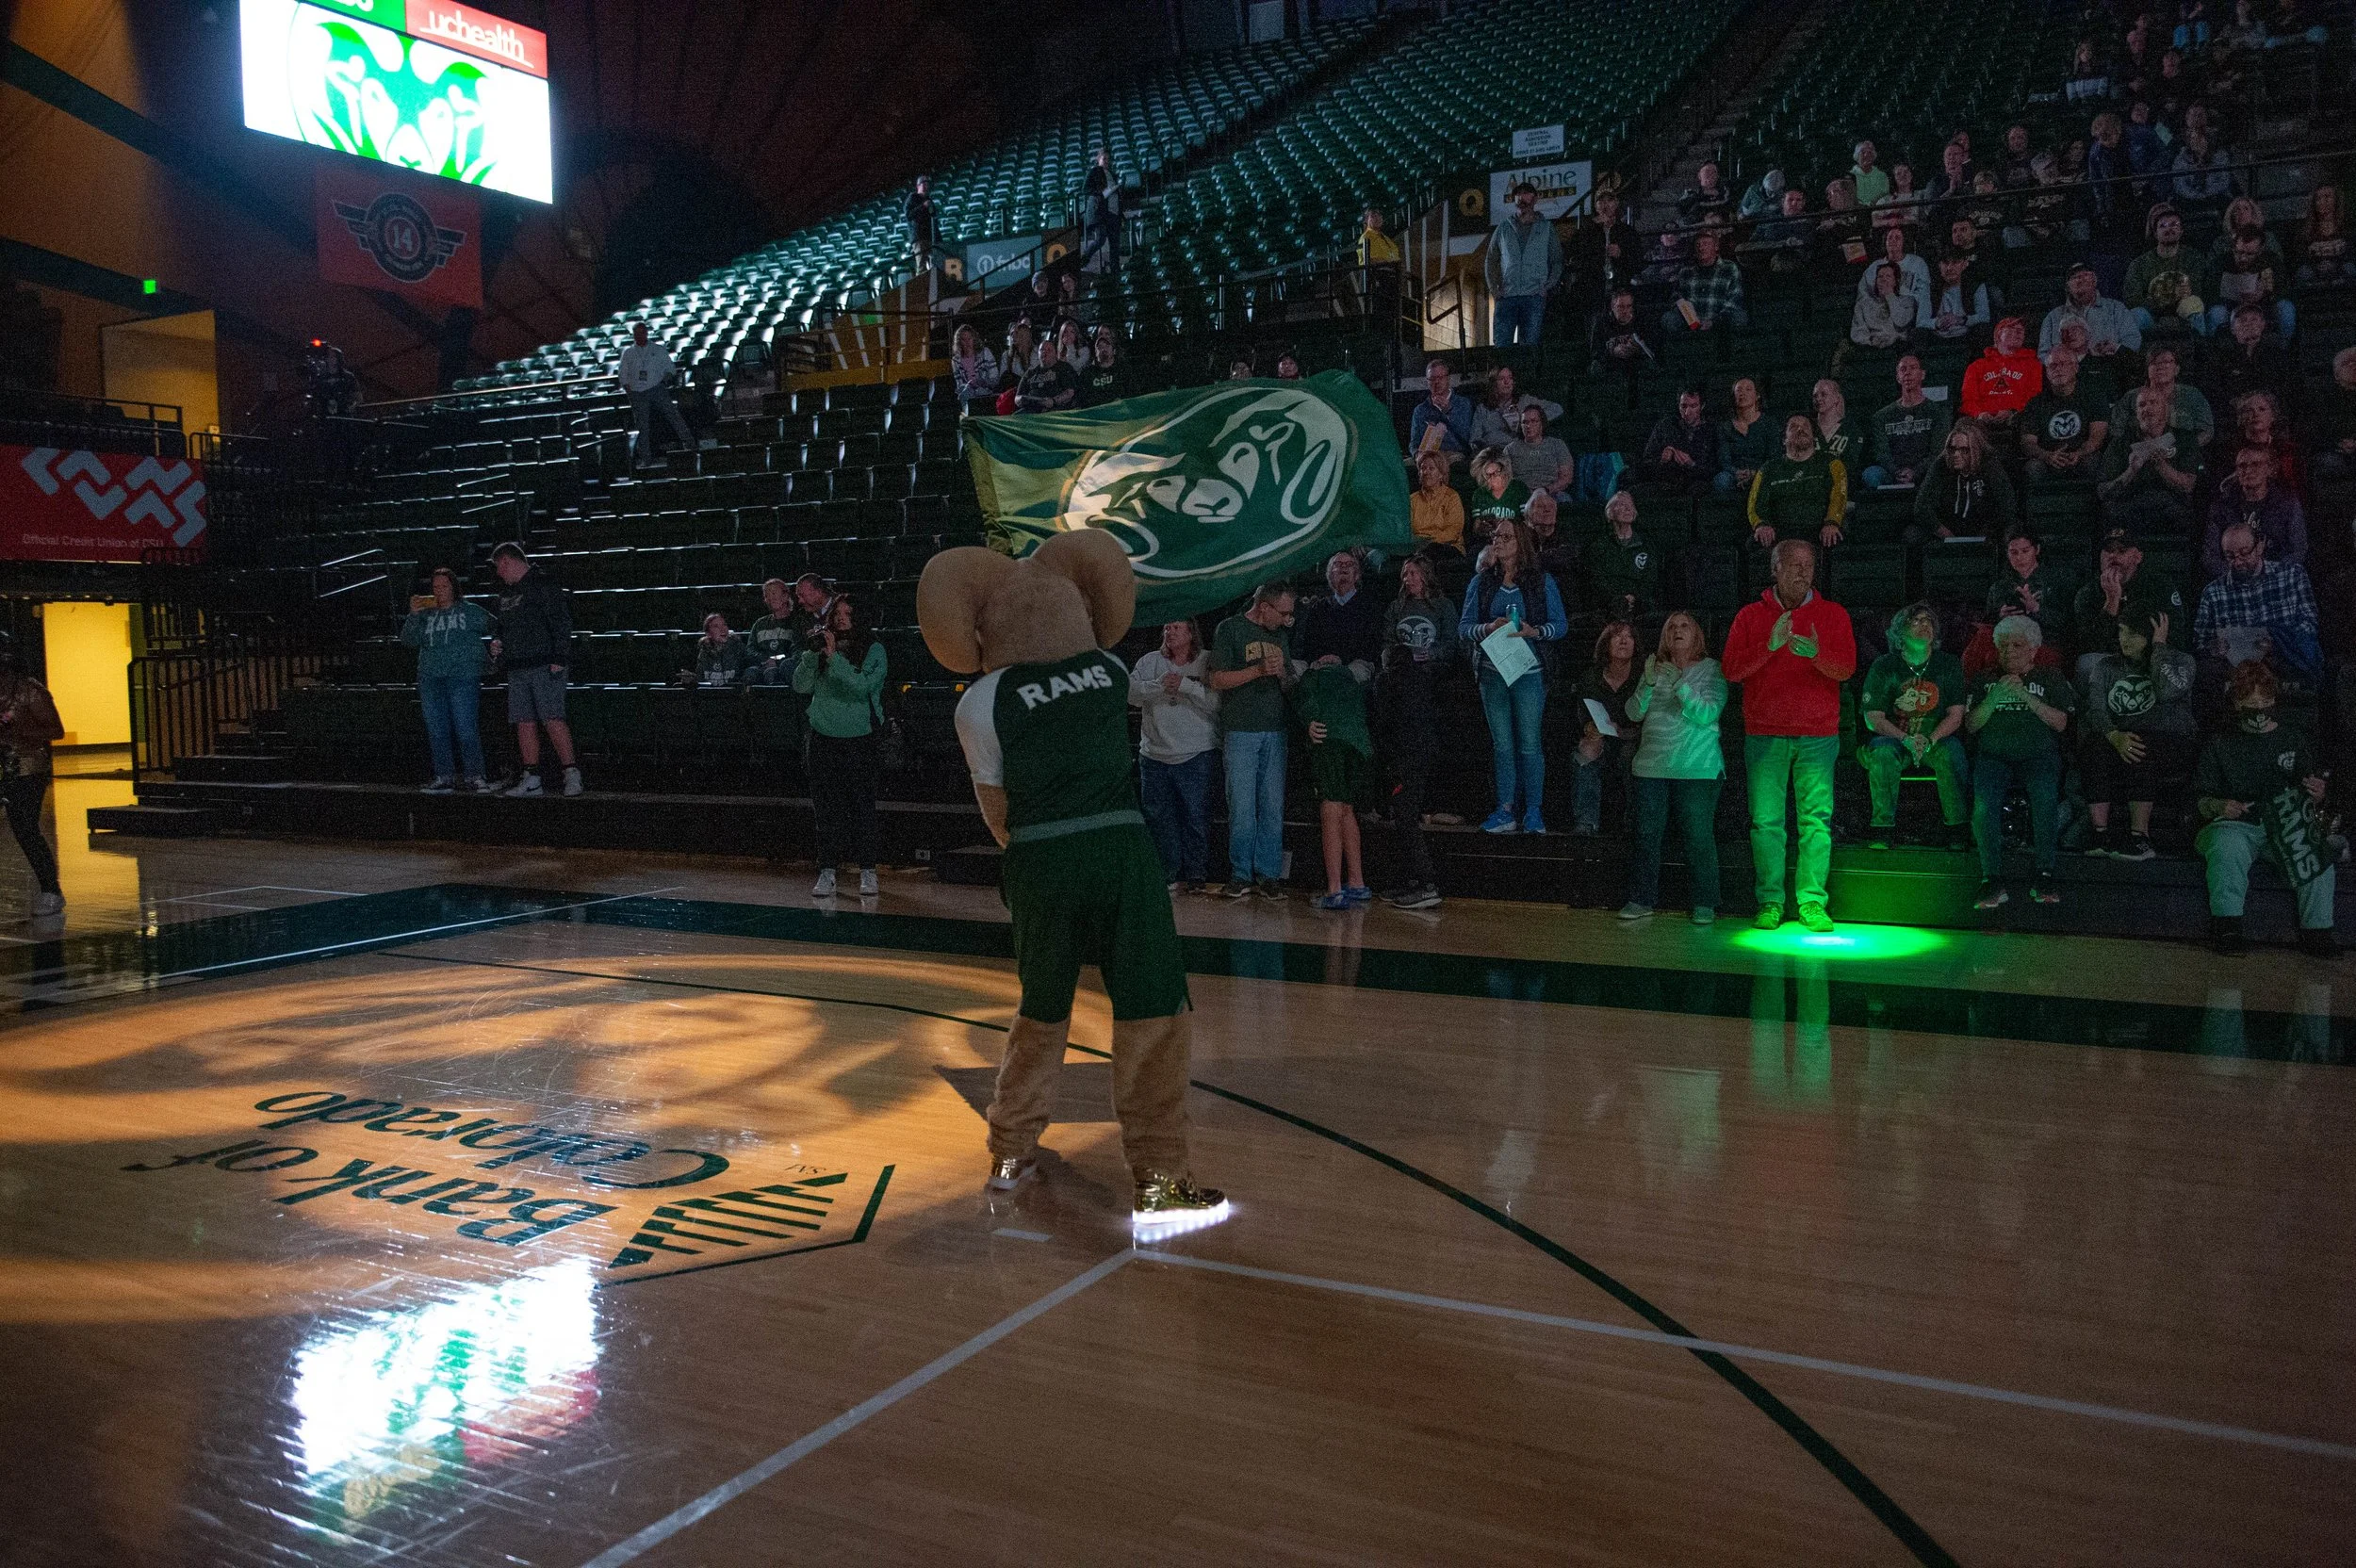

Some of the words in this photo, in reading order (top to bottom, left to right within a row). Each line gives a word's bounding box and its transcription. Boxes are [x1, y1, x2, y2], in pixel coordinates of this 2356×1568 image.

[429, 9, 525, 61] uchealth
[1508, 169, 1577, 188] Alpine
[392, 224, 414, 253] 14
[22, 533, 59, 547] Official
[97, 537, 127, 547] Union
[1017, 664, 1113, 710] RAMS
[121, 1139, 319, 1172] of
[254, 1091, 730, 1190] Colorado
[271, 1158, 618, 1247] Bank
